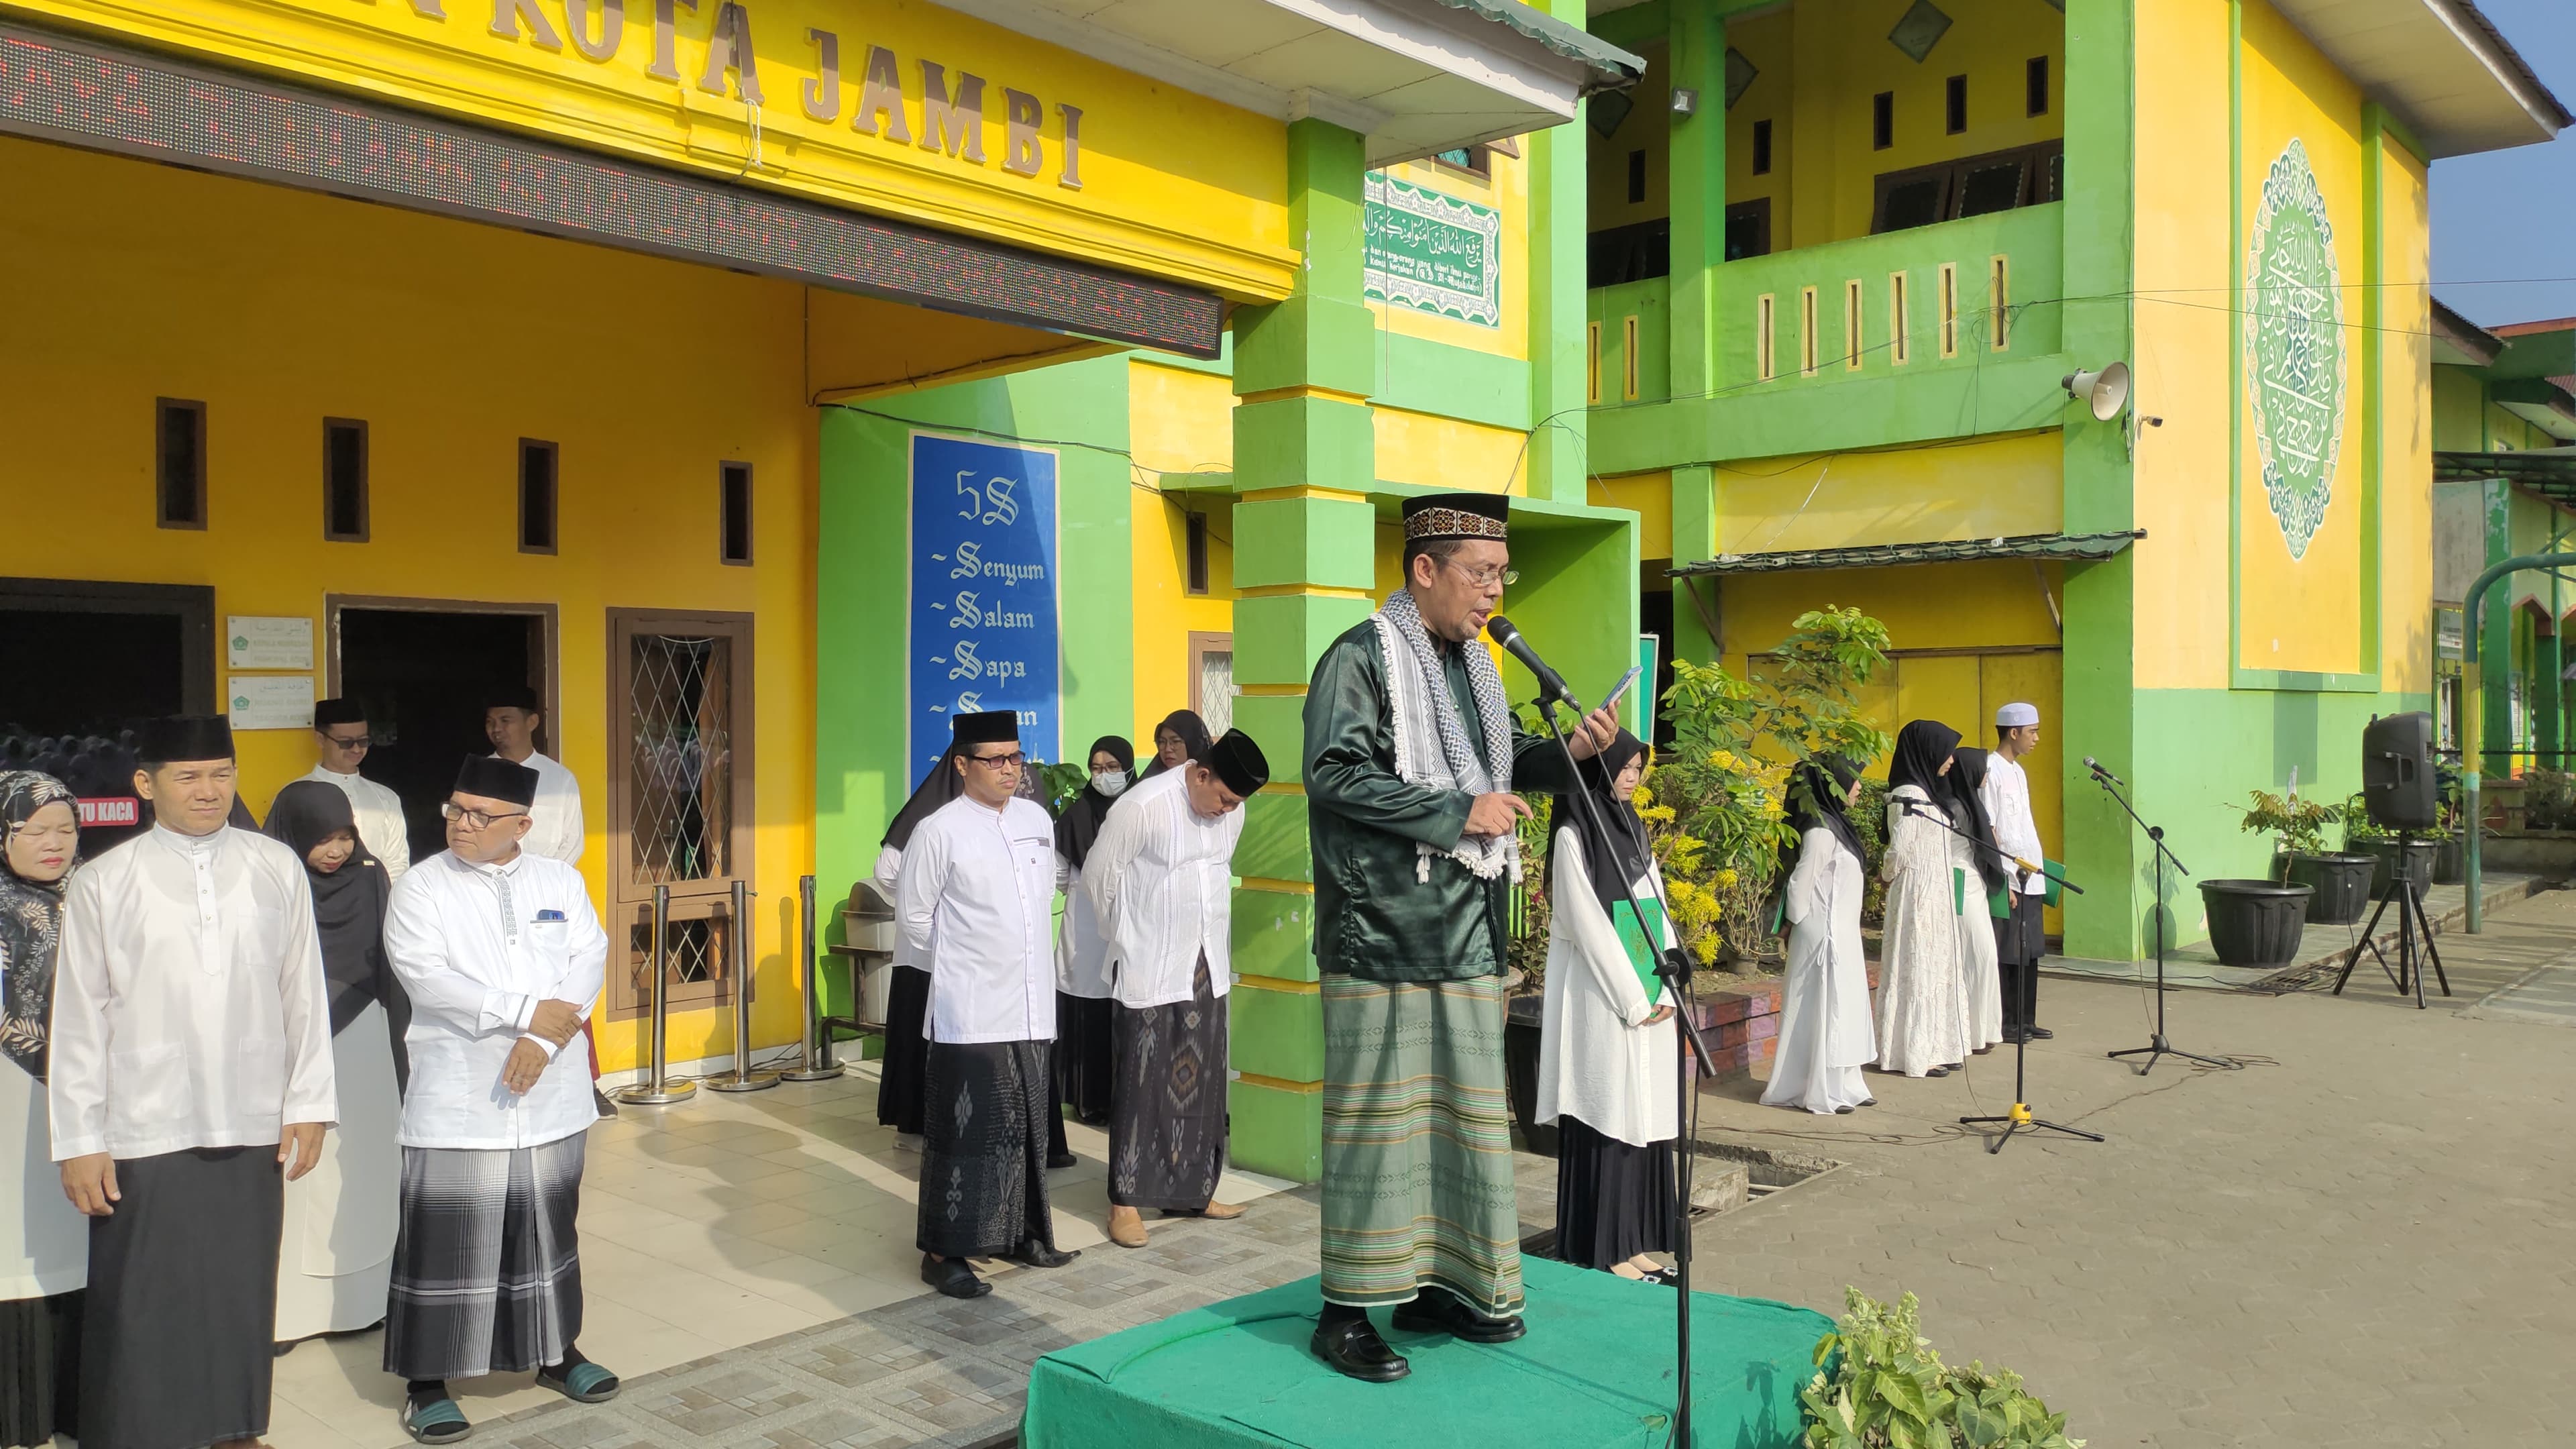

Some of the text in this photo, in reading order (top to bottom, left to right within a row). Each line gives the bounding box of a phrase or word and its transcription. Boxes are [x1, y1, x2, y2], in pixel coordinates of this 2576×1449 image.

[800, 28, 1083, 191] JAMBI
[956, 470, 1020, 526] 5S
[78, 801, 134, 822] TU KACA
